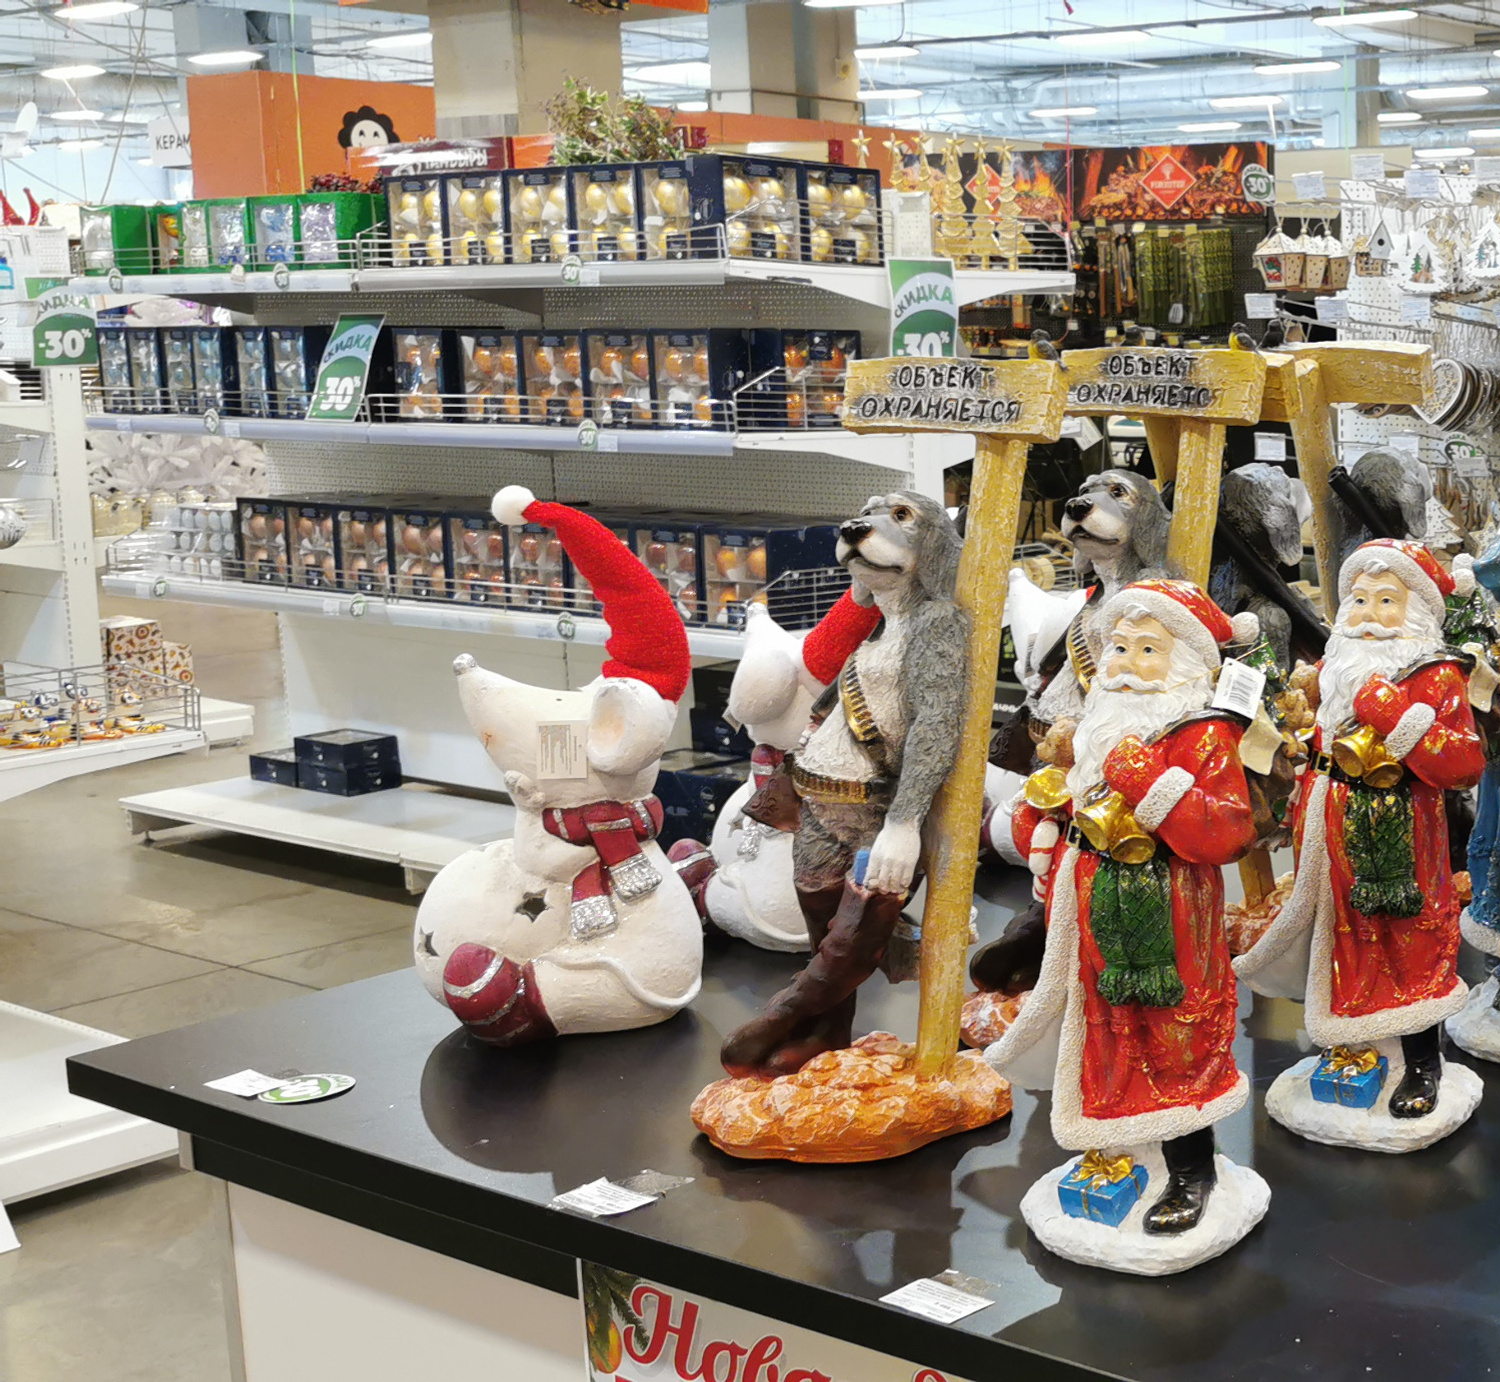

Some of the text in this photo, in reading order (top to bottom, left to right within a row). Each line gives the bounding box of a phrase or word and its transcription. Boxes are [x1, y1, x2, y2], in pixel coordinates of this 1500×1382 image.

[894, 283, 954, 319] СКИДКА
[38, 328, 92, 359] -30%
[323, 333, 373, 363] СКИДКА
[899, 365, 994, 389] ОБЪЕКТ
[1109, 355, 1198, 376] ОБЪЕКТ
[1077, 384, 1225, 408] ОХРАНЯЕТСЯ
[861, 397, 1022, 422] ОХРАНЯЕТСЯ
